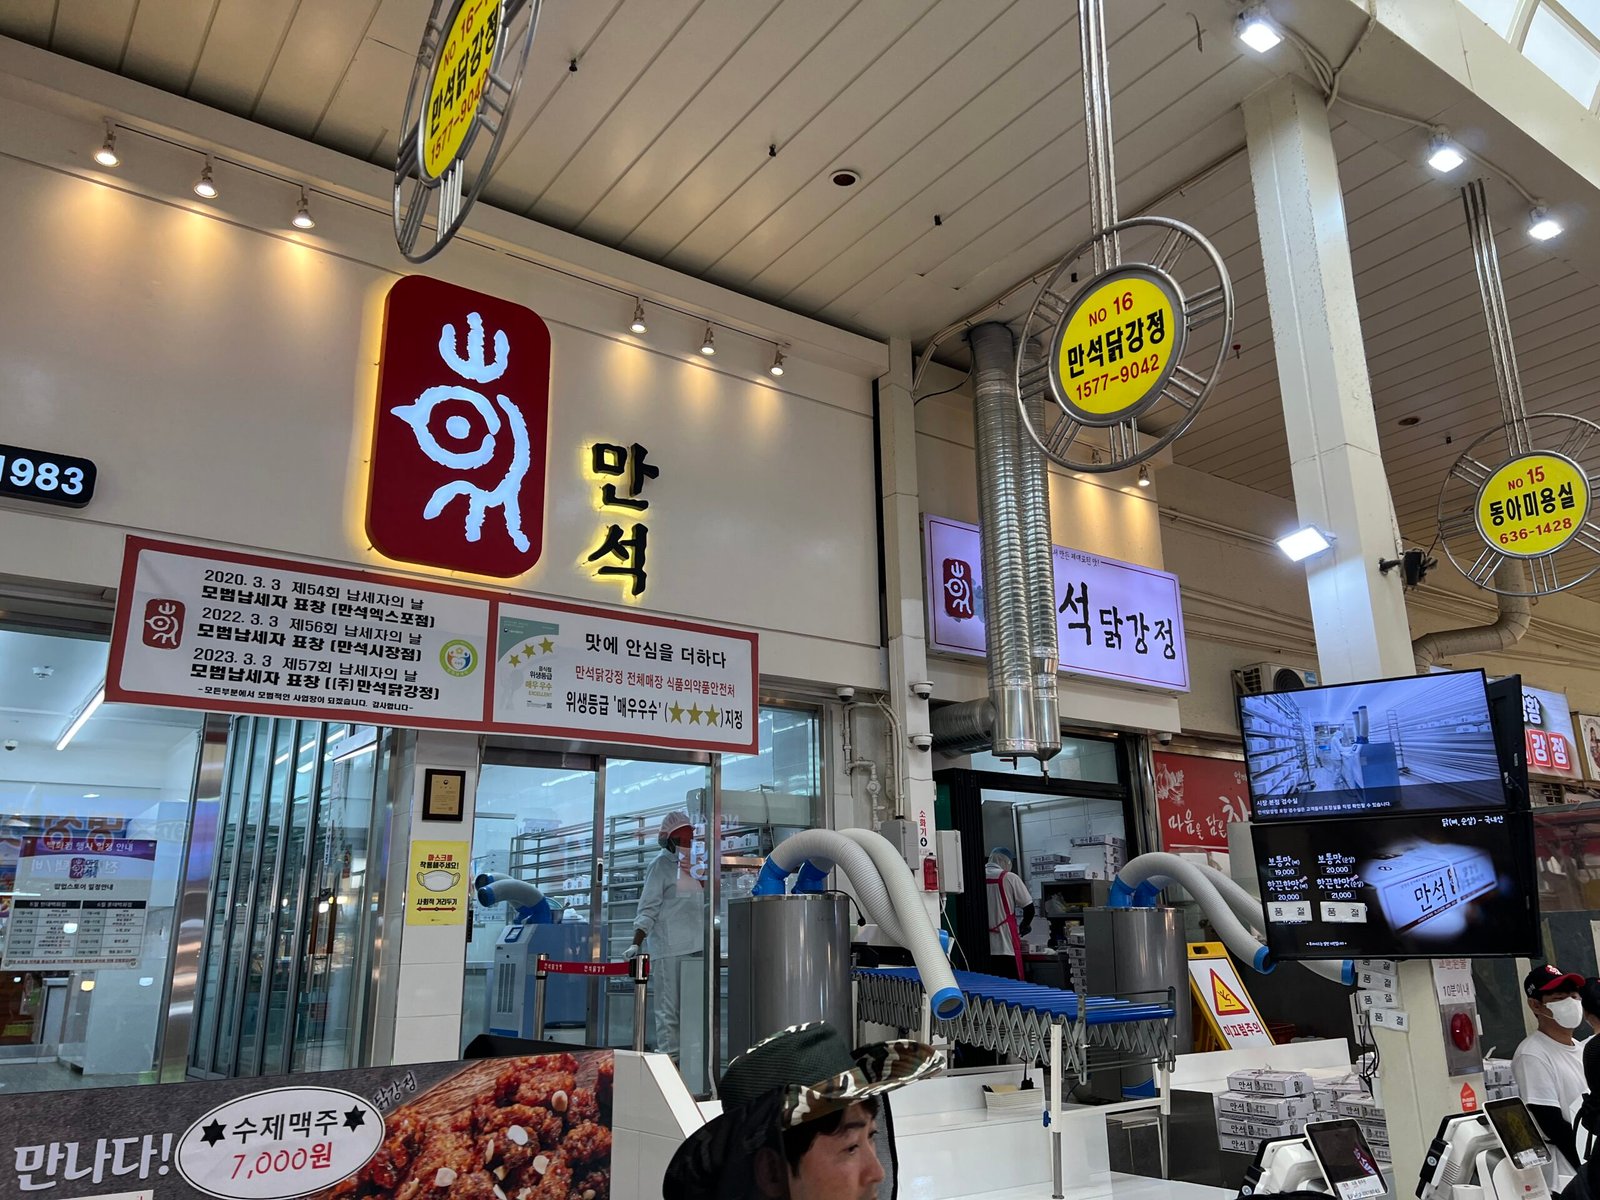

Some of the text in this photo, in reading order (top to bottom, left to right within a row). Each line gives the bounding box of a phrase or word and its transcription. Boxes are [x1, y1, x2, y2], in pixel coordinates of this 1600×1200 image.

[443, 0, 488, 71] NO 16-
[431, 2, 498, 138] 만석닭강정
[431, 67, 490, 165] 1577-9042
[1089, 292, 1133, 327] NO 16
[1067, 308, 1165, 378] 만석닭강정
[1076, 353, 1160, 400] 1577-9042
[1508, 466, 1545, 491] NO 15
[586, 443, 659, 597] 만석
[1489, 481, 1575, 526] 동아미용실
[1500, 518, 1572, 544] 636-1428
[202, 585, 288, 609] 모범납세자
[294, 598, 326, 614] 표창
[204, 569, 424, 611] 2020. 3. 3 제54회 납세자의 날
[197, 623, 286, 647] 모범납세자
[292, 635, 324, 651] 표창
[330, 640, 422, 662] (만석시장점)
[202, 607, 422, 645] 2022. 3. 3 제56회 납세자의 날
[193, 647, 418, 683] 2023. 3. 3 제57회 납세자의 날
[585, 633, 727, 669] 맛에 안심을 더하다
[190, 663, 280, 685] 모범납세자
[286, 673, 320, 689] 표창
[530, 671, 552, 680] 위생등급
[575, 665, 735, 698] 만석닭강정 전체매장 식품의약품안전처
[258, 691, 290, 701] 모범적인
[293, 694, 325, 704] 사업장이
[565, 691, 610, 716] 위생등급
[1526, 734, 1567, 764] 강정
[919, 810, 927, 837] 소화기
[1168, 808, 1204, 840] 마음을
[1206, 813, 1227, 838] 담은
[1484, 815, 1503, 824] 국내산
[46, 841, 133, 852] 백화점 행사 일정 안내
[420, 861, 459, 869] 착용해주세요!
[1326, 866, 1349, 874] 20,000
[1414, 877, 1447, 912] 만석
[1223, 1022, 1263, 1038] 미끄럼주의
[374, 1071, 416, 1110] 닭강정
[232, 1110, 338, 1144] 수제맥주
[14, 1133, 173, 1191] 만나다!
[231, 1142, 333, 1179] 7,000원
